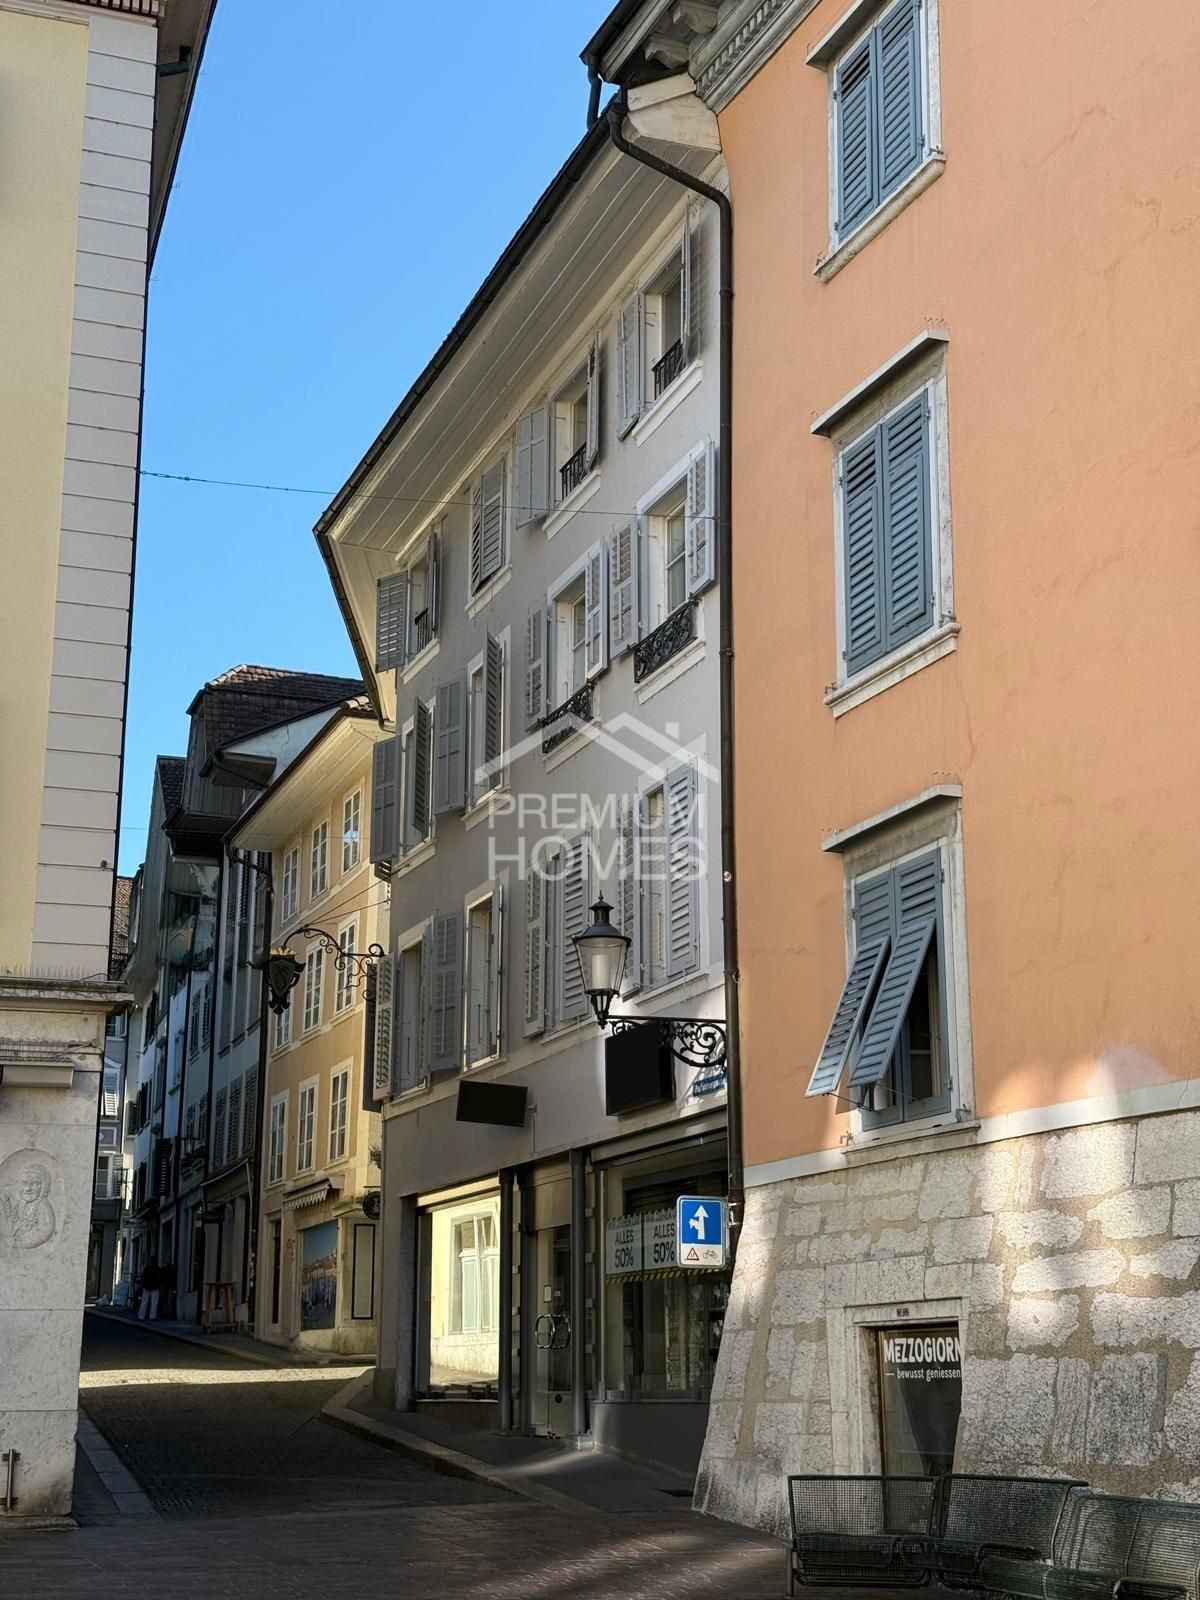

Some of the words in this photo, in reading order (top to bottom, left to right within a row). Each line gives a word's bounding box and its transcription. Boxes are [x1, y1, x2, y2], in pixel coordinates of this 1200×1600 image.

[615, 1230, 634, 1245] ALLES
[653, 1223, 675, 1240] ALLES
[615, 1247, 634, 1268] 50%
[653, 1241, 675, 1264] 50%
[896, 1368, 924, 1379] bewusst
[926, 1367, 960, 1382] geniessen
